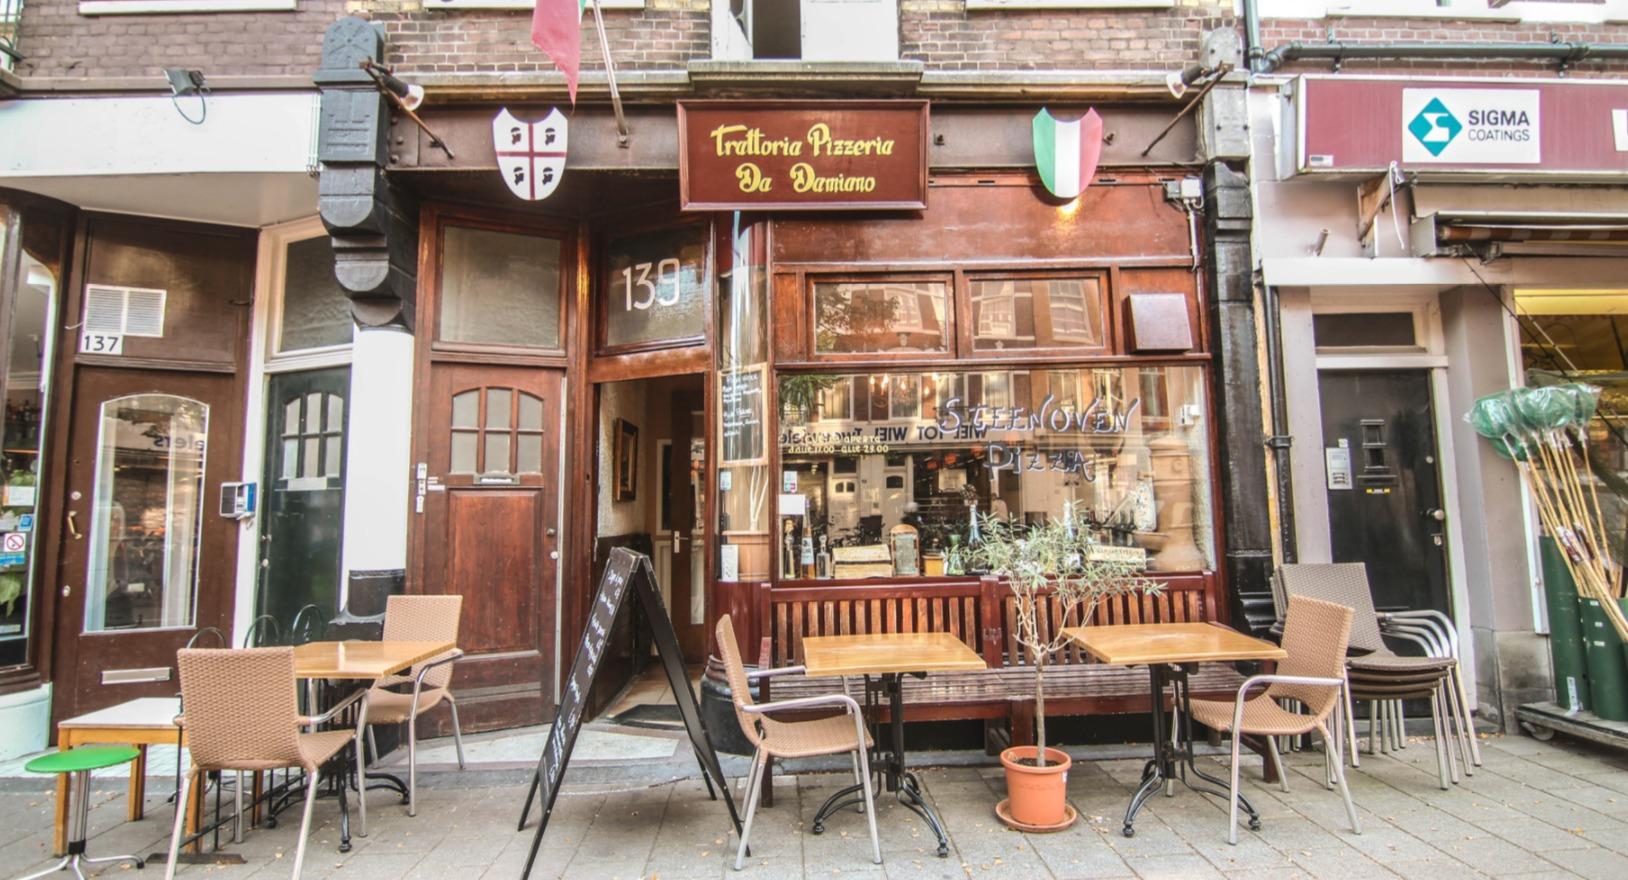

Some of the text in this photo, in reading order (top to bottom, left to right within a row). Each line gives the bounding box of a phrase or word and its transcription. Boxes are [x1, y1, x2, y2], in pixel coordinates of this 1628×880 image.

[1468, 110, 1530, 126] SIGMA
[710, 123, 894, 157] Trattoria Pizzeria
[1468, 129, 1530, 142] COATINGS
[735, 162, 876, 193] Da Damiano
[622, 258, 680, 312] 139
[85, 335, 119, 352] 137
